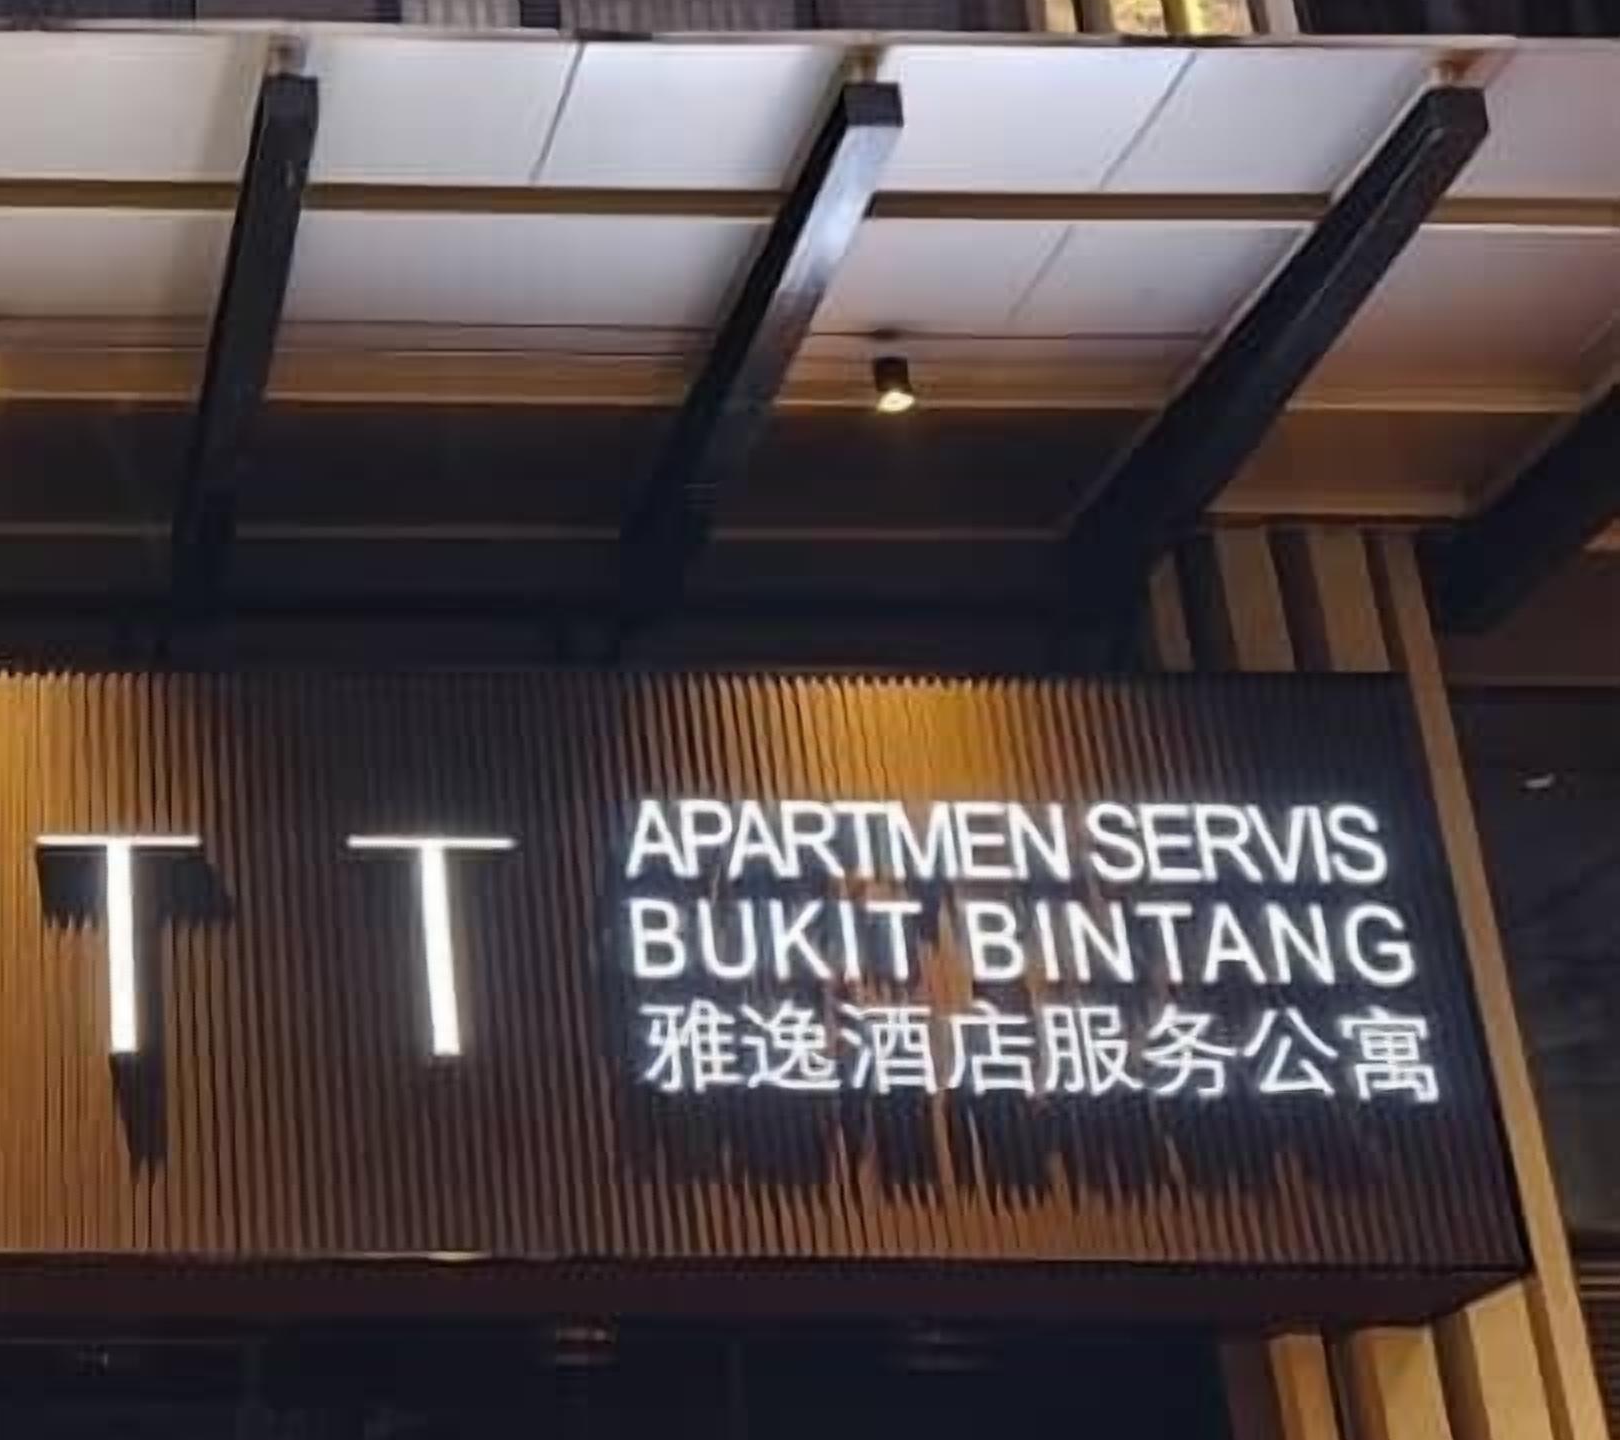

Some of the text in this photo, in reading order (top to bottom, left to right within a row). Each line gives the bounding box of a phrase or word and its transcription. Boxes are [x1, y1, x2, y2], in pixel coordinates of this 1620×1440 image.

[626, 797, 1388, 883] APARTMEN SERVIS
[629, 897, 1415, 987] BUKIT BINTANG
[640, 1000, 1439, 1103] 雅逸酒店服务公寓
